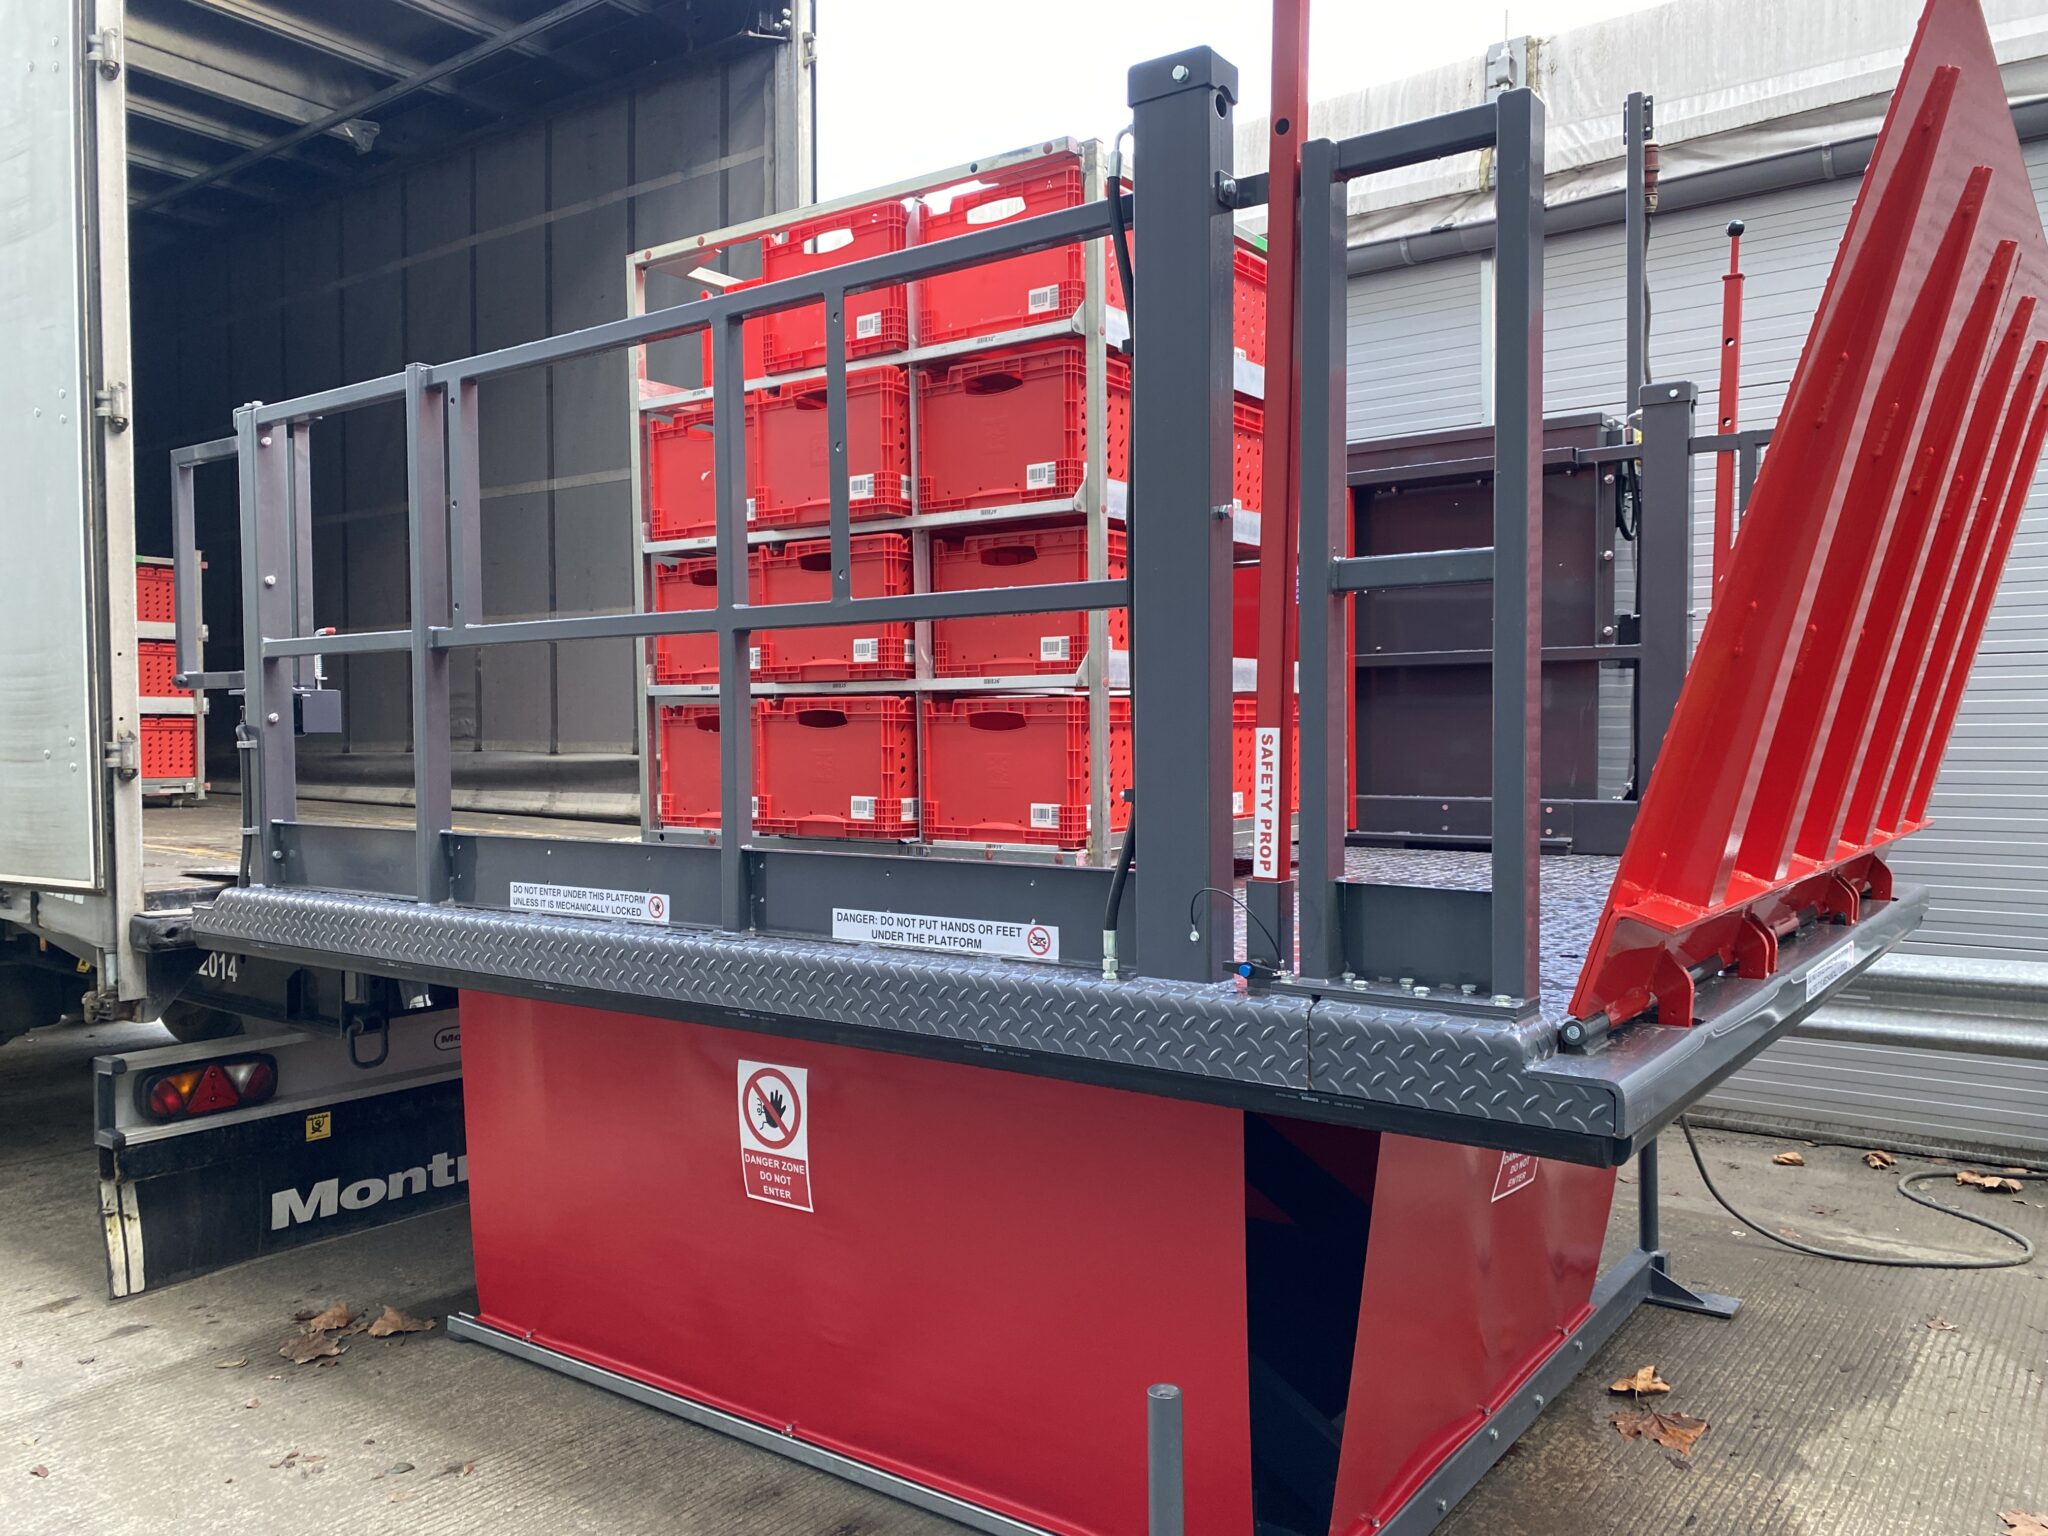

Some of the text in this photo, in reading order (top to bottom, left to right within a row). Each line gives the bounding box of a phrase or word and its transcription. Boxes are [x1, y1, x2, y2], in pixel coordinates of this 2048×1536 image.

[1260, 734, 1273, 872] SAFETY PROP
[513, 885, 646, 904] DO NOT ENTER UNDER THIS PLATFORM
[513, 898, 642, 916] UNLESS IT IS MECHANICALLY LOCKED
[836, 912, 1022, 938] DANGER: DO NOT PUT HANDS OR FEET
[871, 929, 982, 949] UNDER THE PLATFORM
[198, 951, 238, 982] 2014
[744, 1153, 805, 1174] DANGER ZONE
[1510, 1156, 1530, 1174] DO NOT
[760, 1171, 791, 1185] DO NOT
[1507, 1171, 1526, 1187] ENTER
[763, 1185, 791, 1199] ENTER
